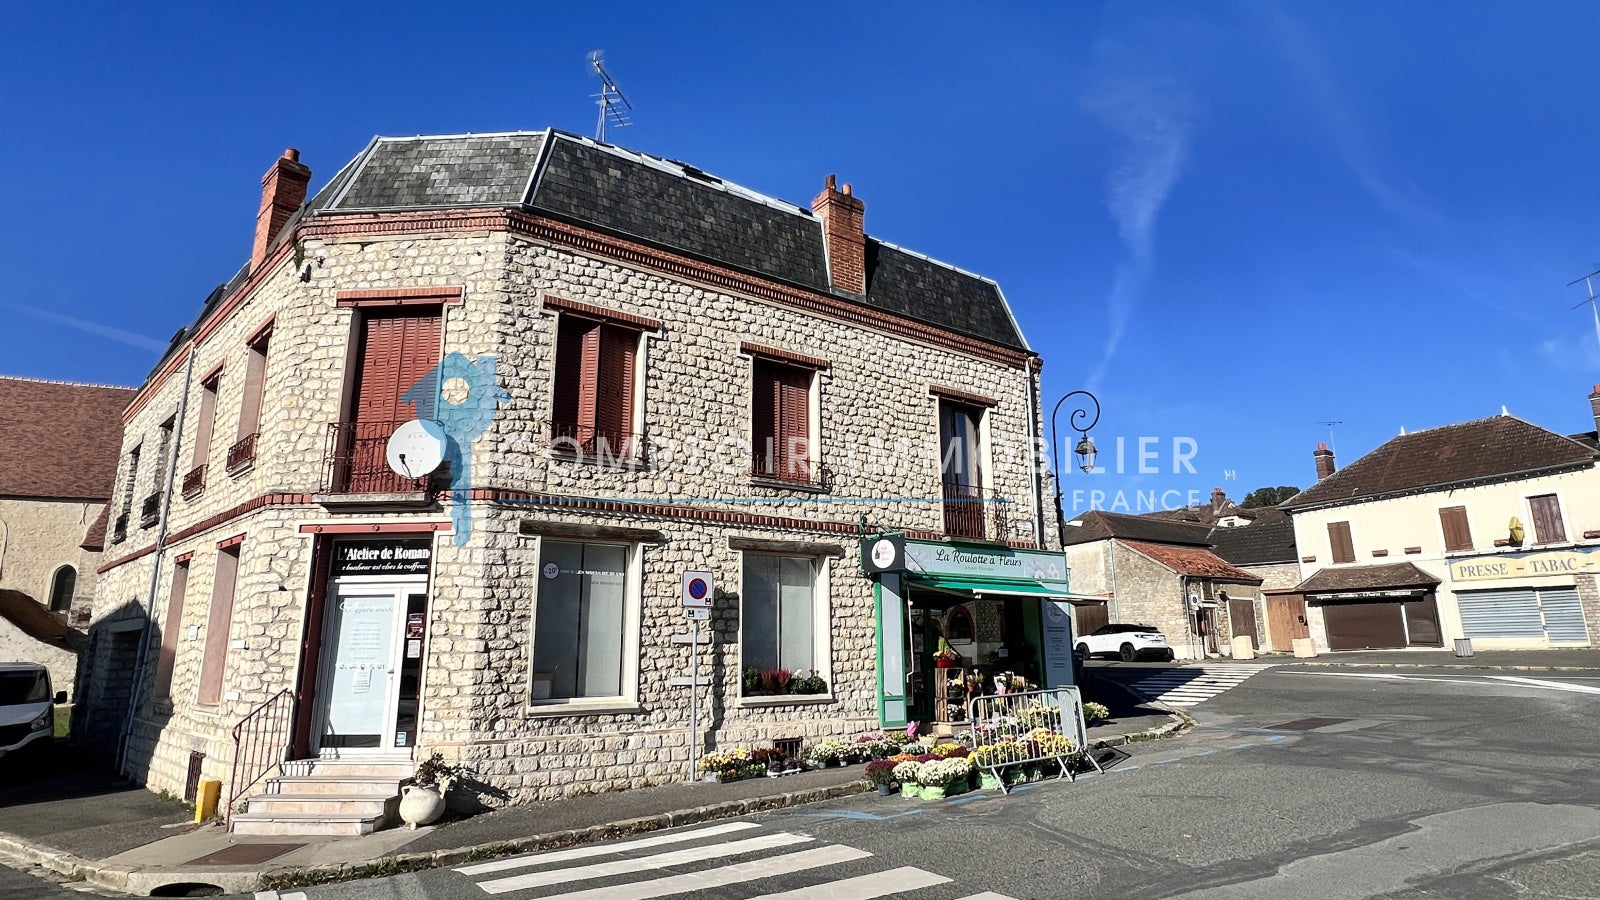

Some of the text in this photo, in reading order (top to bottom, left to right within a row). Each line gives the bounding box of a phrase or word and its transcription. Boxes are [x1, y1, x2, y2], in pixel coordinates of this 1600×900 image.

[380, 546, 393, 560] de
[394, 546, 431, 560] Roman
[936, 549, 950, 562] La
[952, 550, 988, 565] Roulotte
[999, 553, 1022, 567] Fleurs
[1459, 563, 1509, 578] PRESSE
[1530, 557, 1578, 573] TABAC
